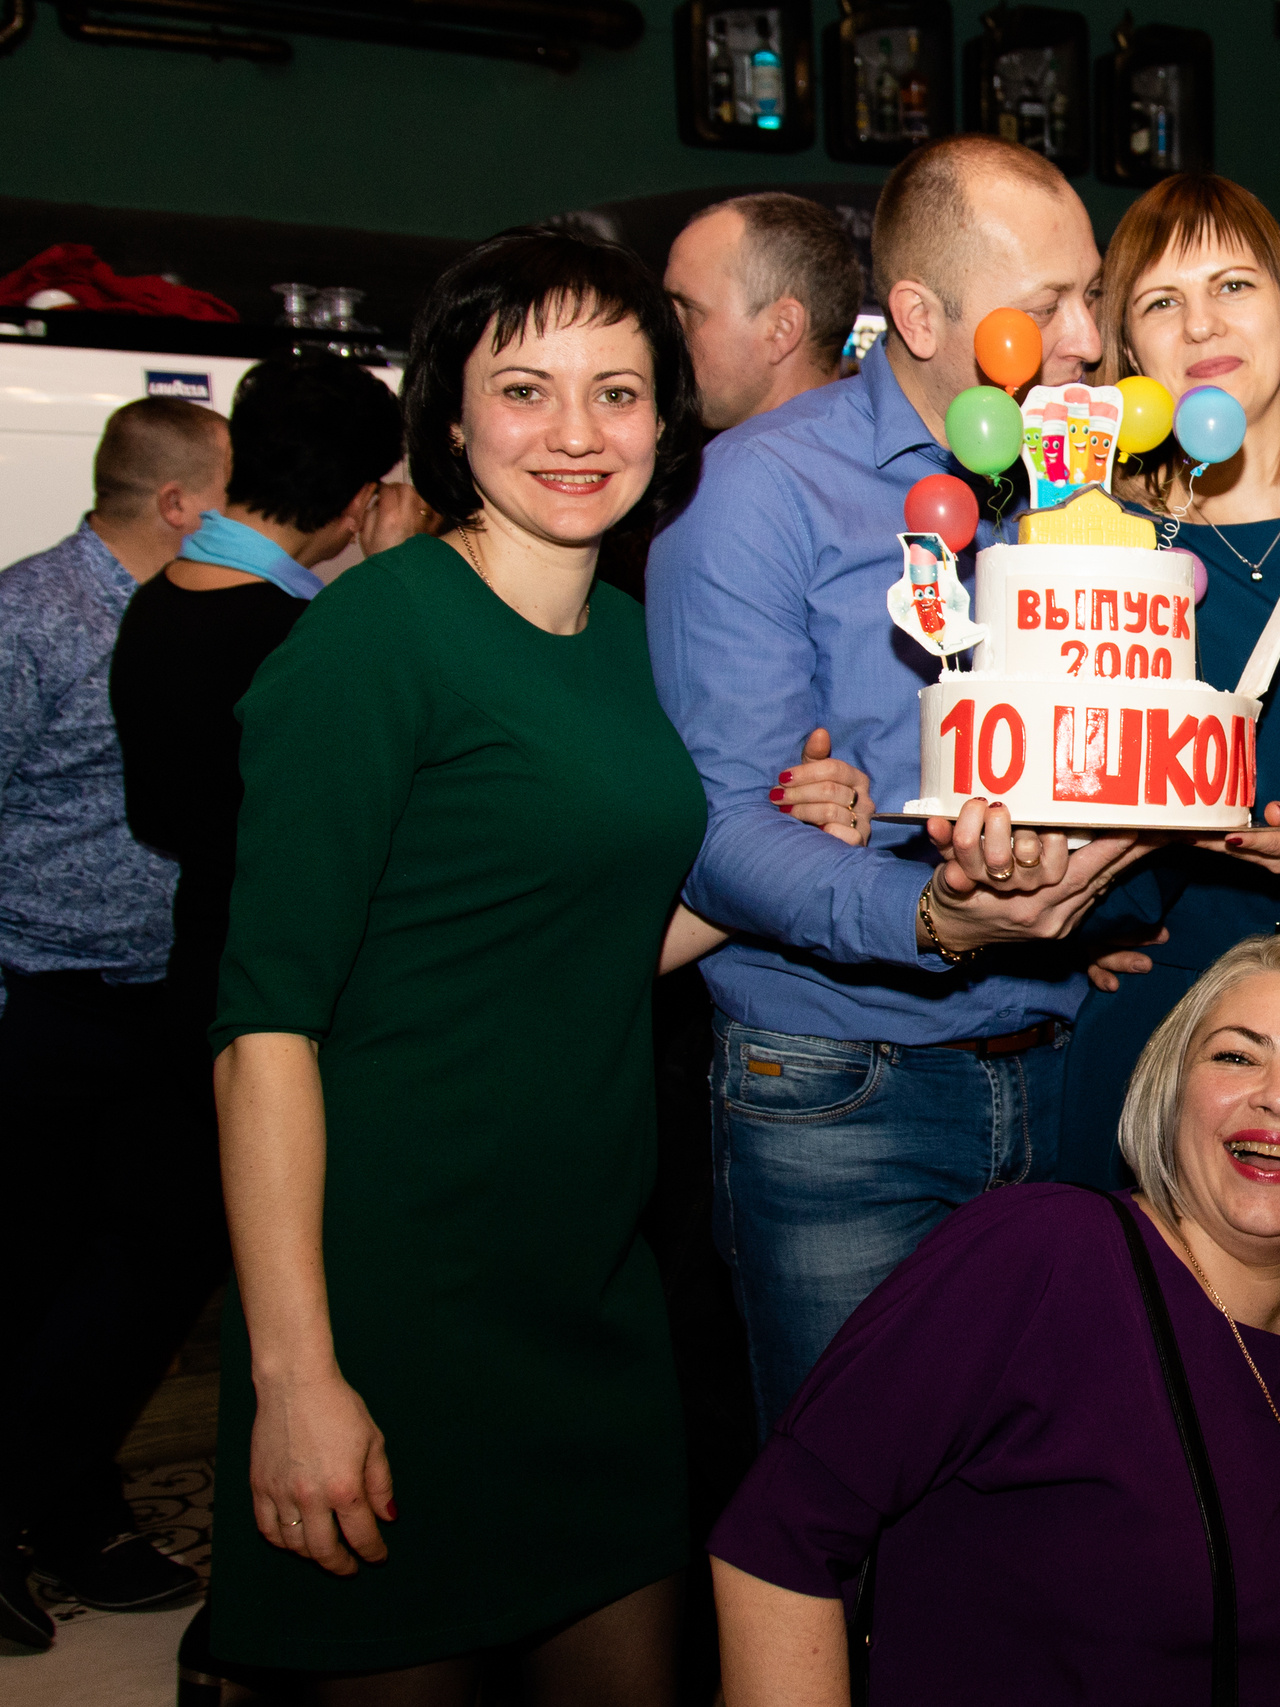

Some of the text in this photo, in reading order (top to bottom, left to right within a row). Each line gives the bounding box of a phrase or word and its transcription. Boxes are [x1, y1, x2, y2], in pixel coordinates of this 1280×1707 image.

[1018, 589, 1190, 640] ВЫПУСК
[1061, 640, 1172, 679] 2000
[941, 699, 1257, 807] 10 ШКОЛ
